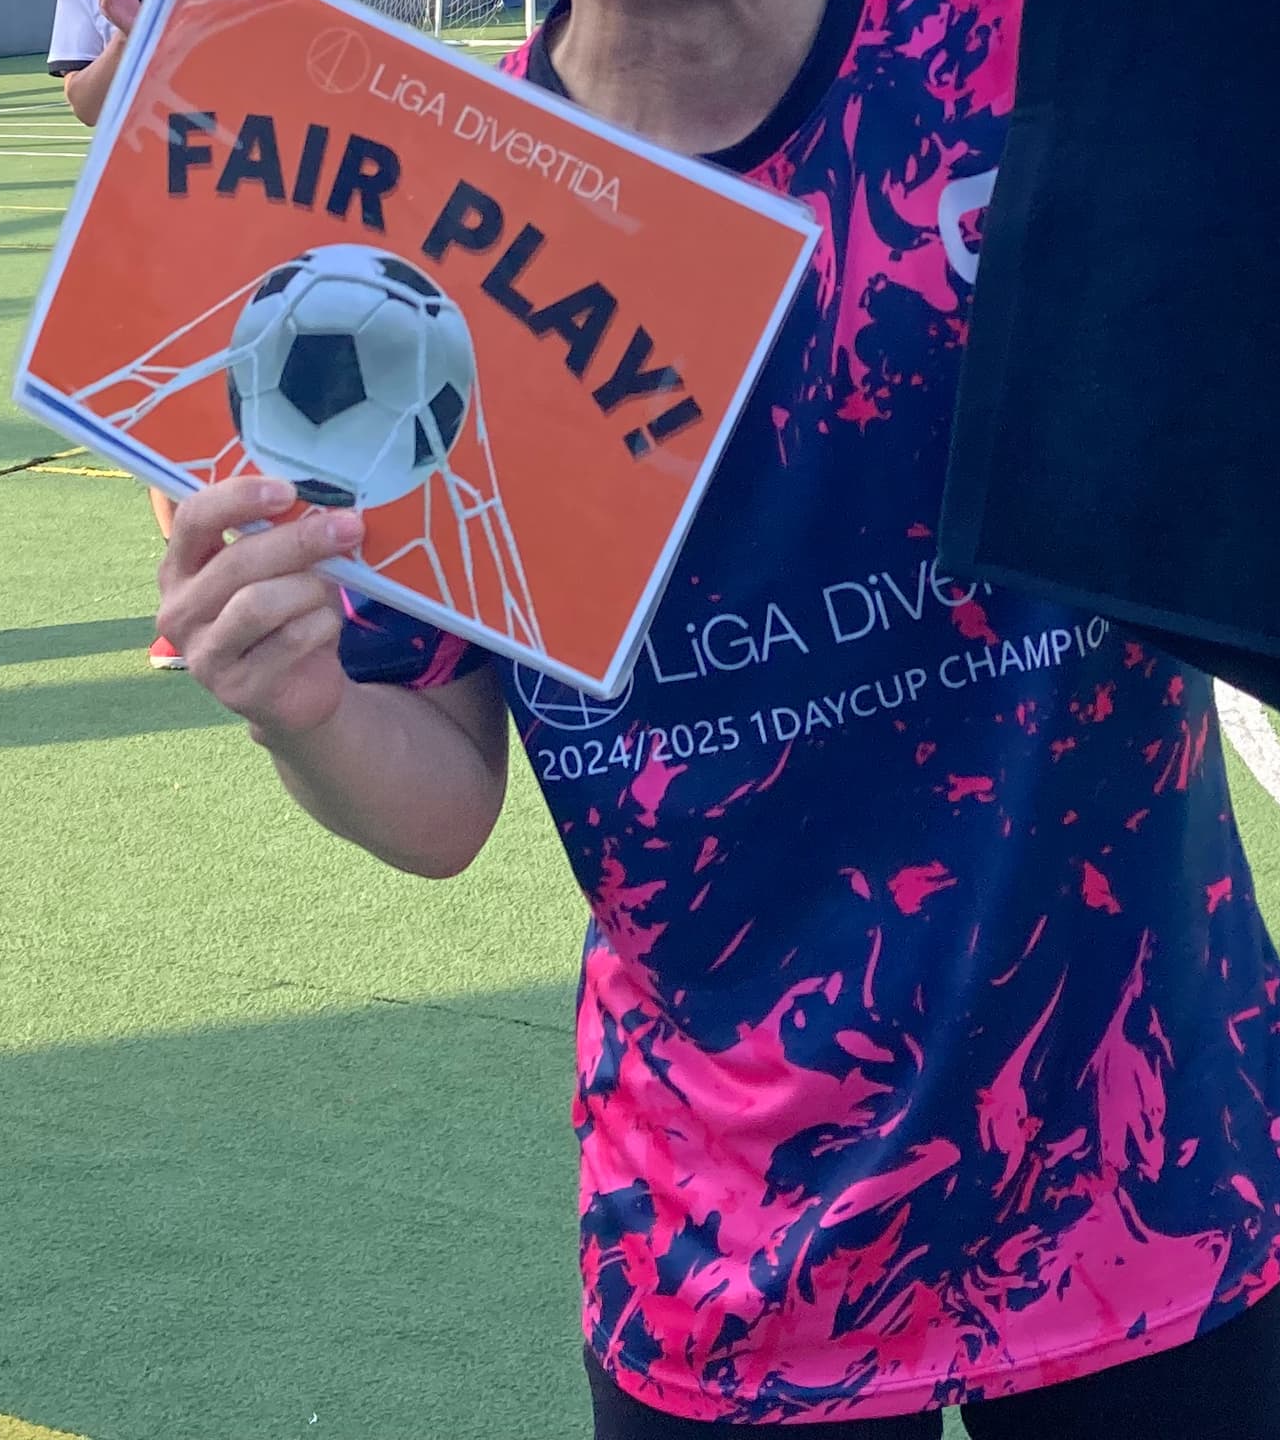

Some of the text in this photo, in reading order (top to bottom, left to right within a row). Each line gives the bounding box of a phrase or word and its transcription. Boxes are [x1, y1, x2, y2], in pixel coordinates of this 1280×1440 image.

[167, 111, 401, 233] FAIR
[421, 179, 705, 461] PLAY!
[537, 615, 1110, 782] 2024/2025 1DAYCUP CHAMPIO
